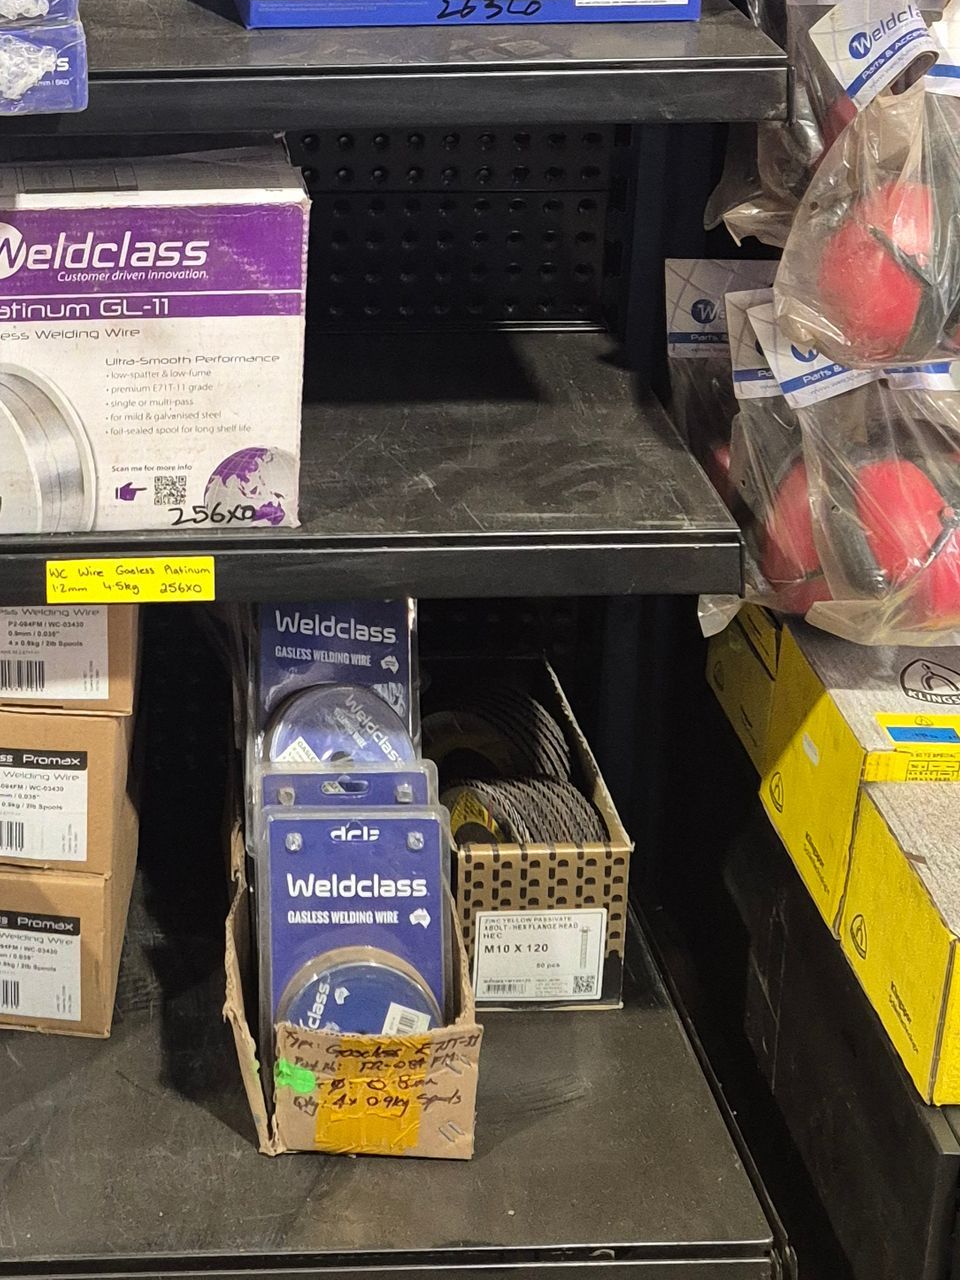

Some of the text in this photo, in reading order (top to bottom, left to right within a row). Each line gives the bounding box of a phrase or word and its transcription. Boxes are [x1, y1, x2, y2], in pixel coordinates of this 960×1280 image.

[57, 269, 110, 282] Customer
[111, 269, 145, 280] driven
[100, 298, 169, 317] GL-11
[35, 329, 100, 341] Welding
[105, 327, 140, 338] Wire
[106, 353, 280, 367] Ultra-Smooth Performance
[276, 610, 397, 644] Weldclass
[275, 646, 371, 666] GASLESS WELDING WIRE
[23, 754, 81, 766] Promax
[286, 873, 427, 897] Weldclass
[17, 917, 74, 931] Promax
[331, 910, 373, 924] WELDING
[375, 910, 399, 923] WIRE
[527, 944, 548, 952] 120
